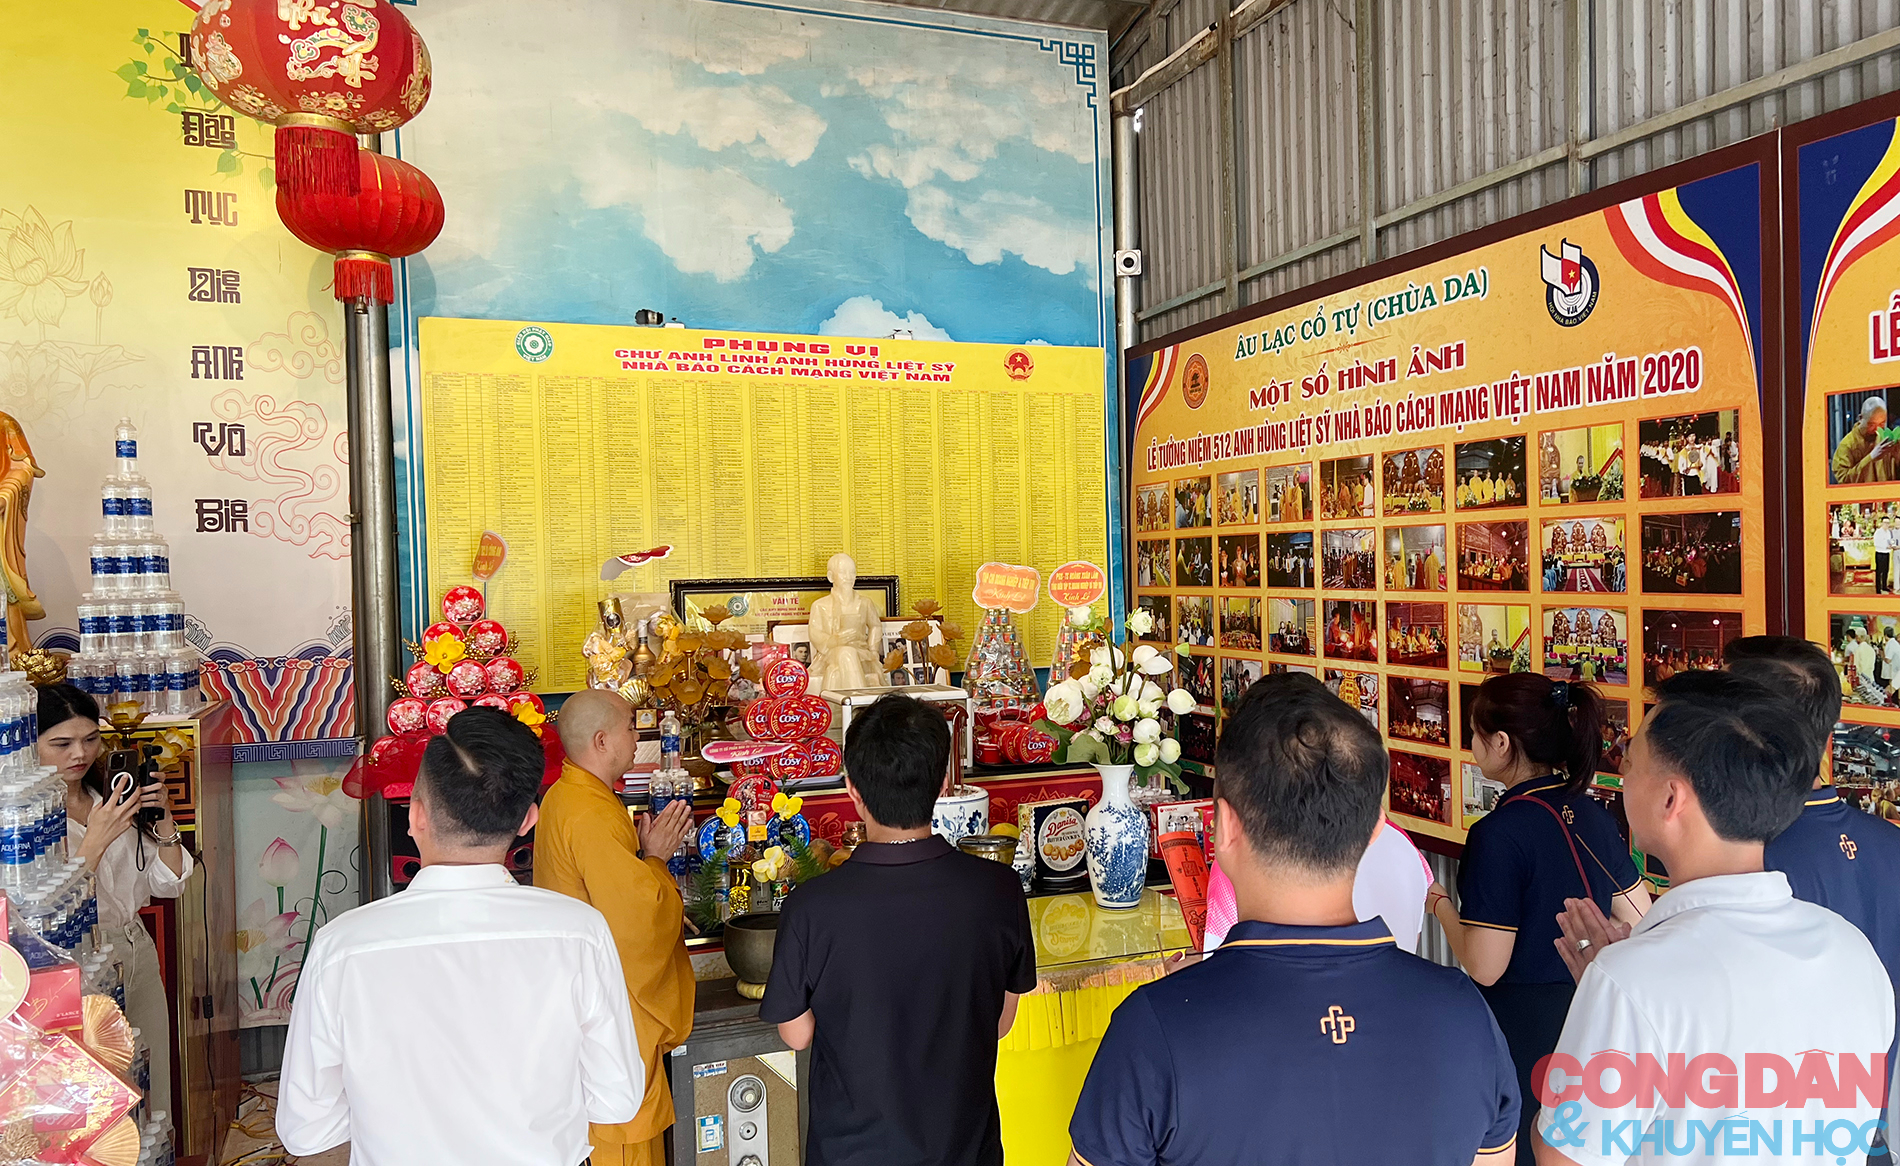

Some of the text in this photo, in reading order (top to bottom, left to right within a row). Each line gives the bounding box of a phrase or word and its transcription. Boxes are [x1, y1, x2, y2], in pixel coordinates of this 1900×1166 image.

[1235, 269, 1489, 359] ÂU LẠC CỔ TỰ (CHÙA DA)
[703, 338, 879, 358] PHỤNG VỊ
[614, 349, 662, 360] CHƯ
[667, 351, 712, 362] ANH
[720, 353, 768, 364] LINH
[775, 356, 818, 367] ANH
[825, 356, 880, 369] HÙNG
[886, 360, 925, 372] LIỆT
[622, 360, 950, 382] NHÀ BÁO CÁCH MẠNG VIỆT NAM
[1250, 379, 1293, 411] MỘT
[1301, 362, 1329, 398] SỐ
[1338, 358, 1396, 391] HÌNH
[1406, 343, 1464, 378] ẢNH
[1188, 432, 1211, 469] NIỆM
[1213, 435, 1231, 460] 512
[1233, 430, 1255, 457] ANH
[1257, 420, 1286, 453] HÙNG
[1288, 414, 1313, 453] LIỆT
[1315, 408, 1331, 445] SỸ
[1334, 403, 1361, 441] NHÀ
[1365, 400, 1392, 436] BÁO
[1396, 391, 1435, 431] CÁCH
[1440, 386, 1489, 432] MẠNG
[1493, 373, 1531, 423] VIỆT
[1536, 369, 1581, 411] NAM
[1587, 354, 1637, 403] NĂM
[1643, 350, 1700, 395] 2020
[776, 674, 797, 684] COSY
[779, 714, 801, 723] COSY
[1027, 741, 1047, 750] COSY
[779, 757, 801, 767] COSY
[1046, 816, 1079, 837] Danisa
[1, 842, 31, 852] AQUAFINA
